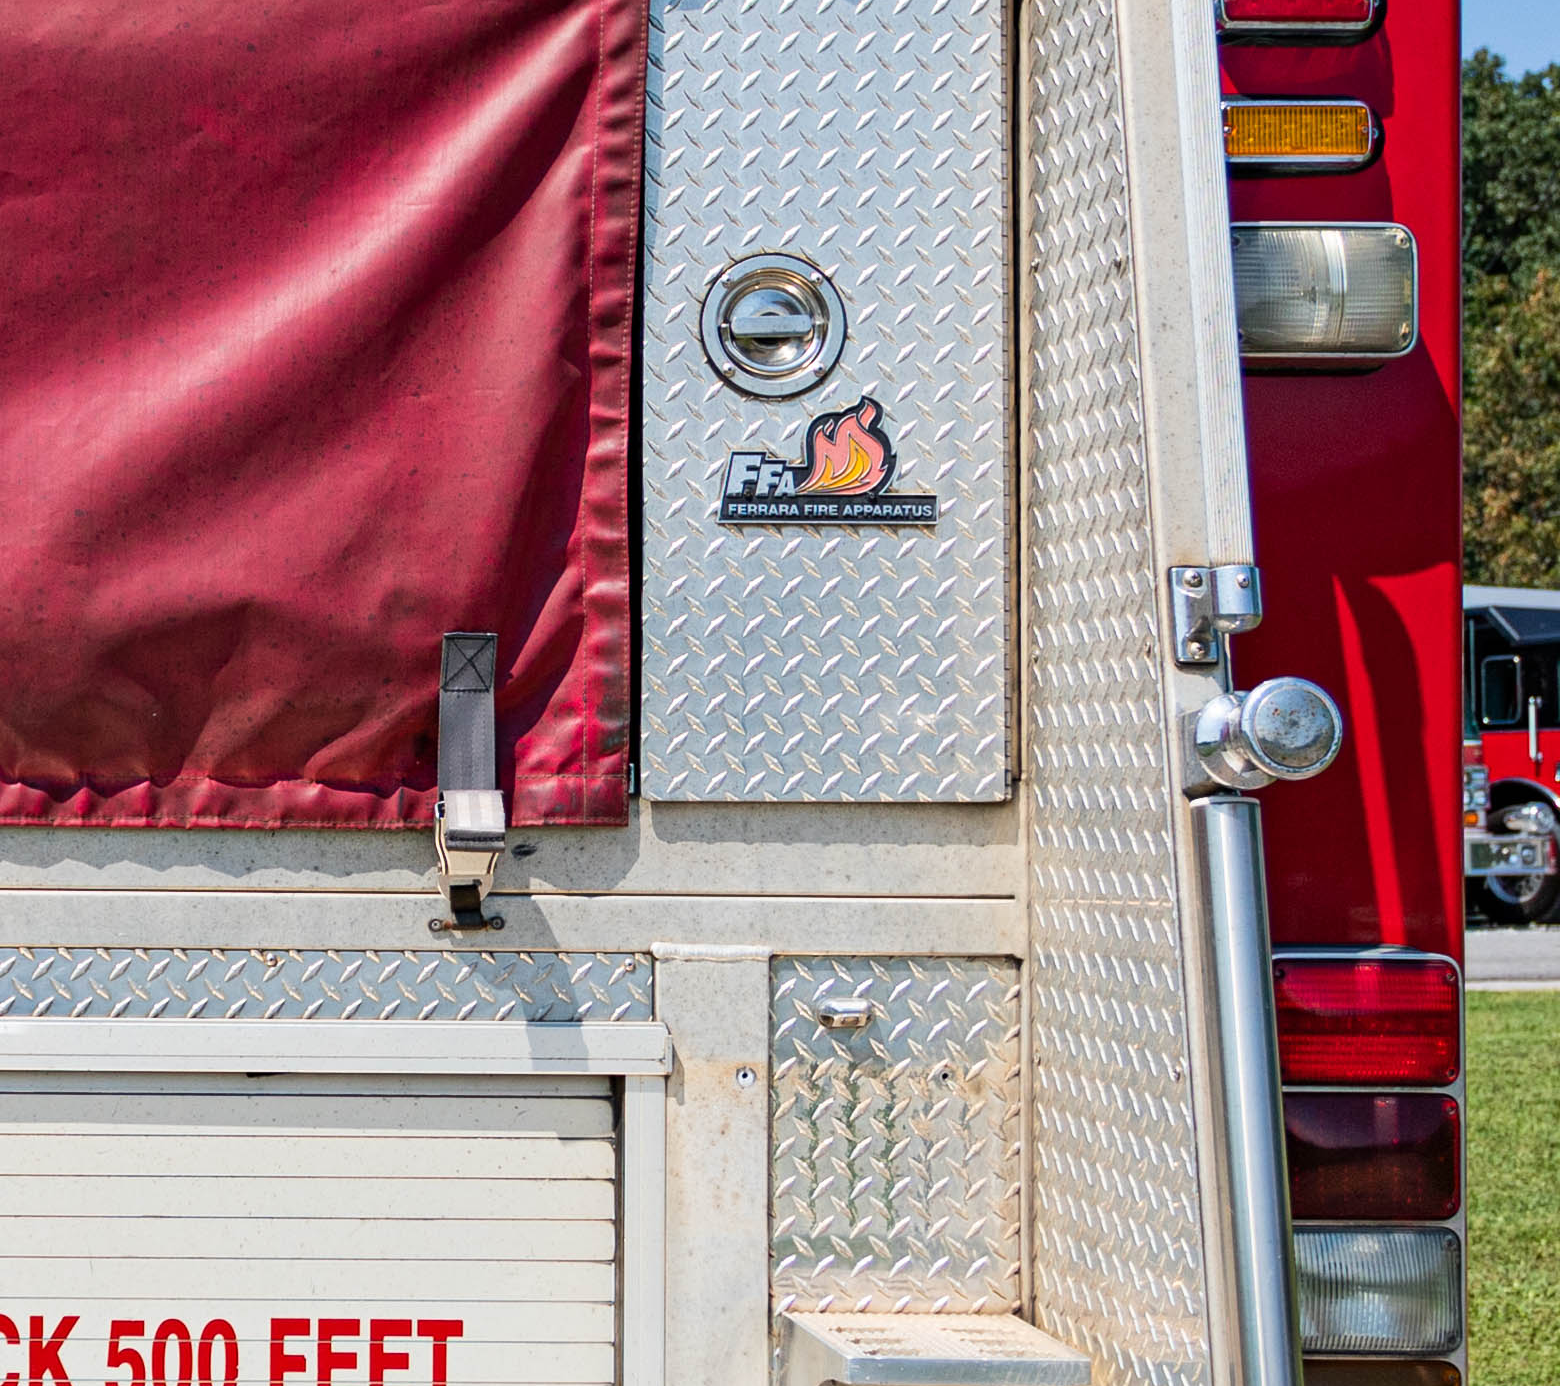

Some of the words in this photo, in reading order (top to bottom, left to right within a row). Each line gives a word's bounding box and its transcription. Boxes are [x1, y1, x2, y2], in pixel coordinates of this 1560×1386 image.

[726, 454, 797, 497] FFA
[728, 503, 800, 516] FERRARA
[804, 504, 839, 517] FIRE
[842, 504, 933, 518] APPARATUS
